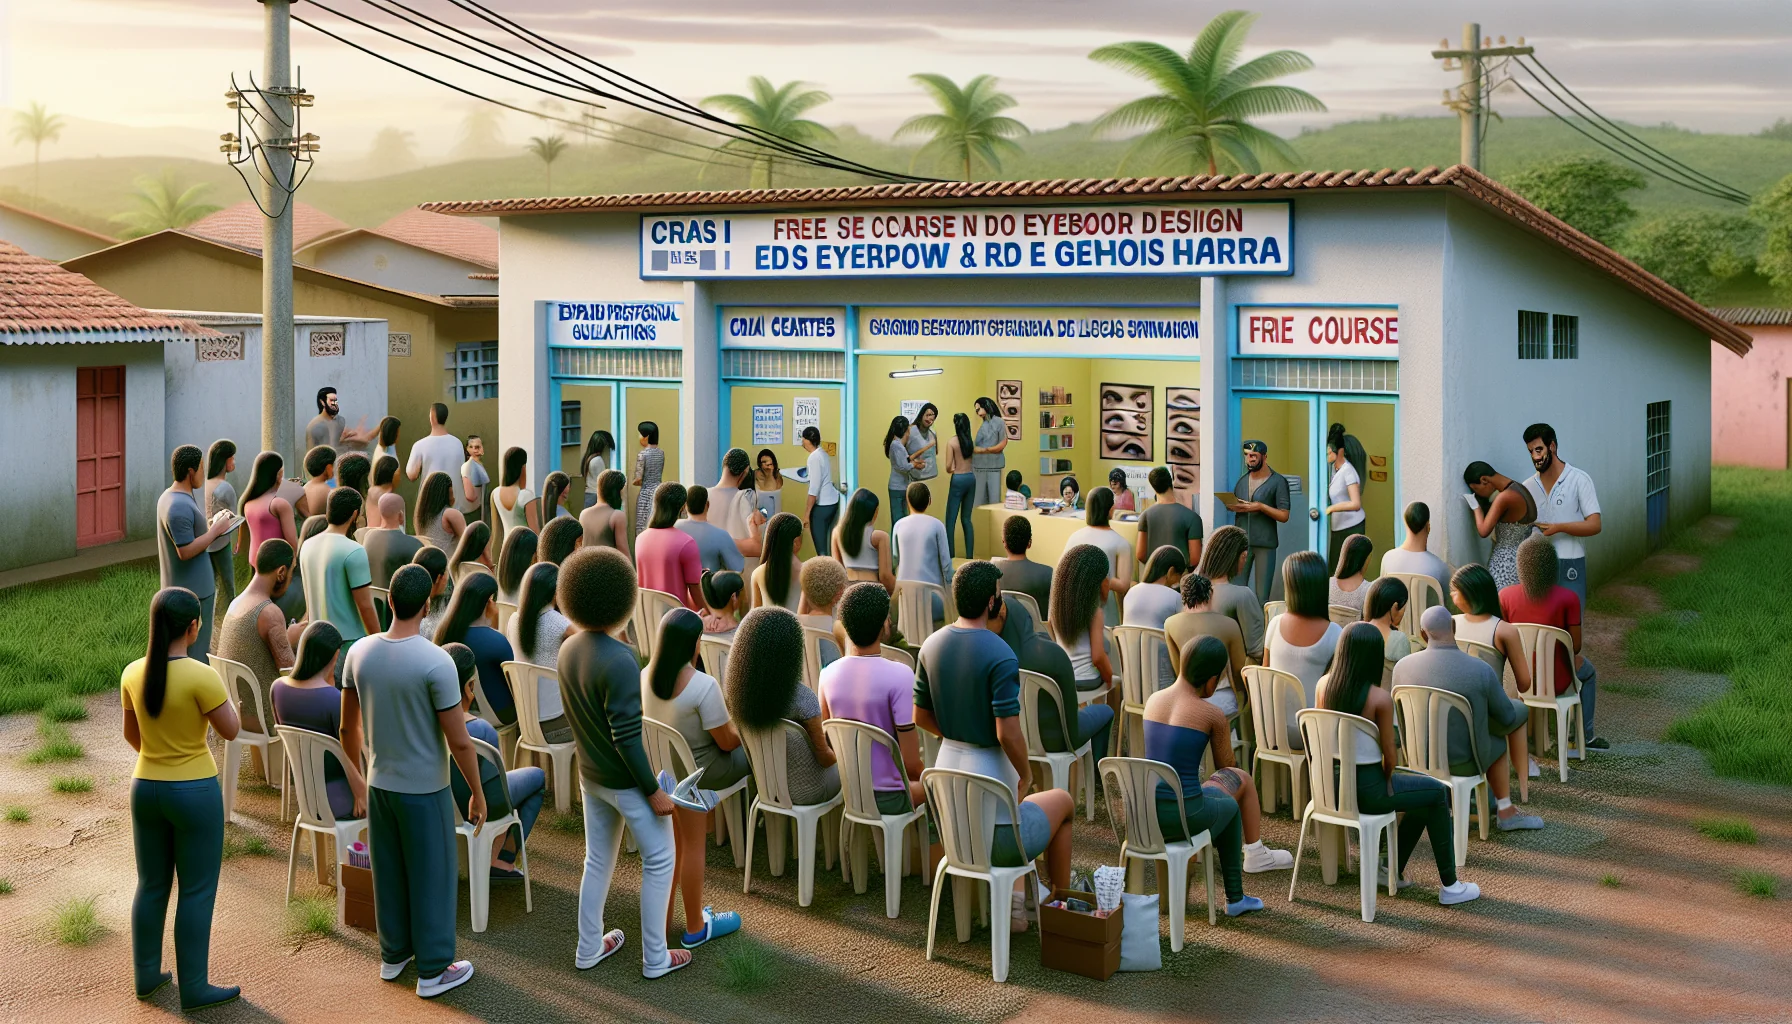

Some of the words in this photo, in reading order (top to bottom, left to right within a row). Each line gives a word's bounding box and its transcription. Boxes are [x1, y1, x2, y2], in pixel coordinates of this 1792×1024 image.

[652, 220, 716, 244] CRAS
[774, 218, 827, 240] FREE
[838, 216, 865, 239] SE
[963, 215, 977, 236] N
[985, 214, 1016, 236] DO
[756, 244, 808, 270] EDS
[816, 242, 950, 270] EYERPOW
[960, 242, 977, 268] &
[985, 242, 1022, 267] RD
[1031, 242, 1046, 266] E
[1055, 238, 1164, 267] GEHOIS
[1173, 236, 1281, 265] HARRA
[1308, 316, 1398, 345] COURSE
